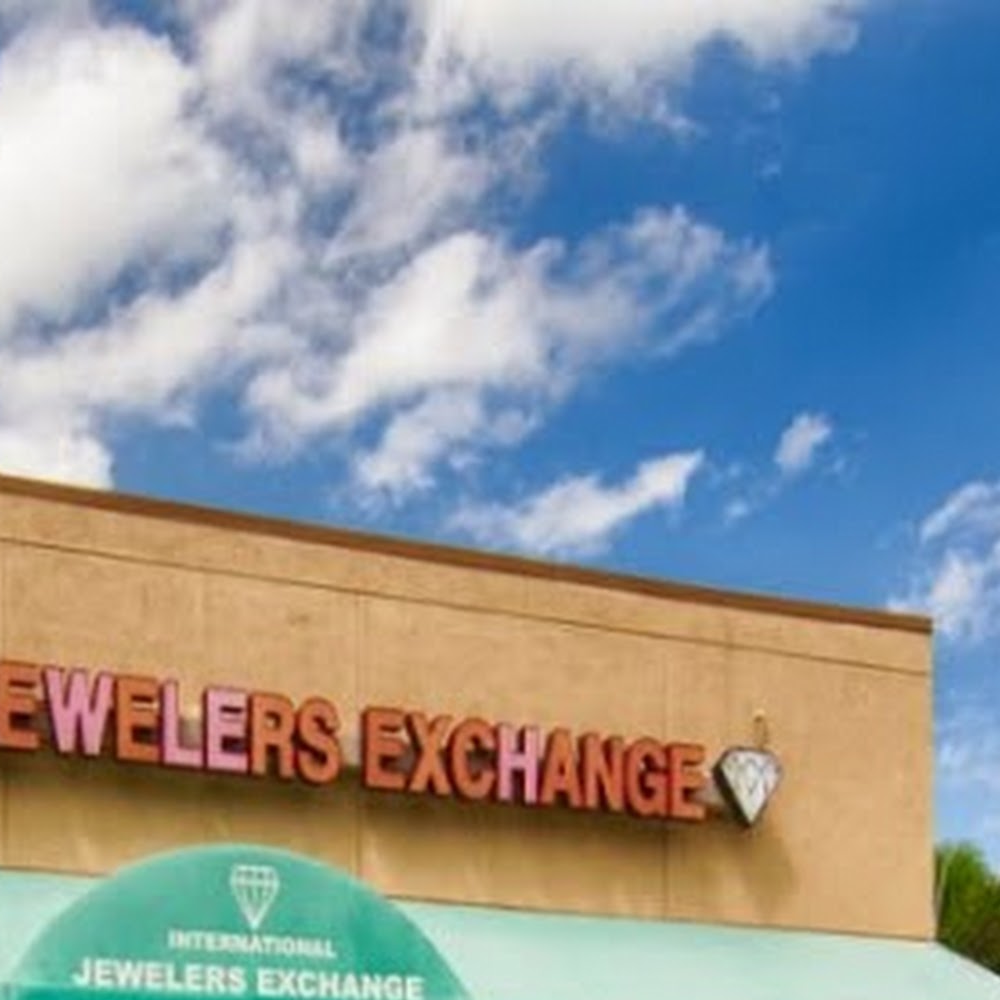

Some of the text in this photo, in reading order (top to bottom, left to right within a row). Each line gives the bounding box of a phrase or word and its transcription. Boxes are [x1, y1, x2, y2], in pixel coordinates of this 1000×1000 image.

[362, 706, 707, 823] EXCHANGE
[167, 929, 337, 959] INTERNATIONAL
[72, 958, 247, 993] JEWELERS
